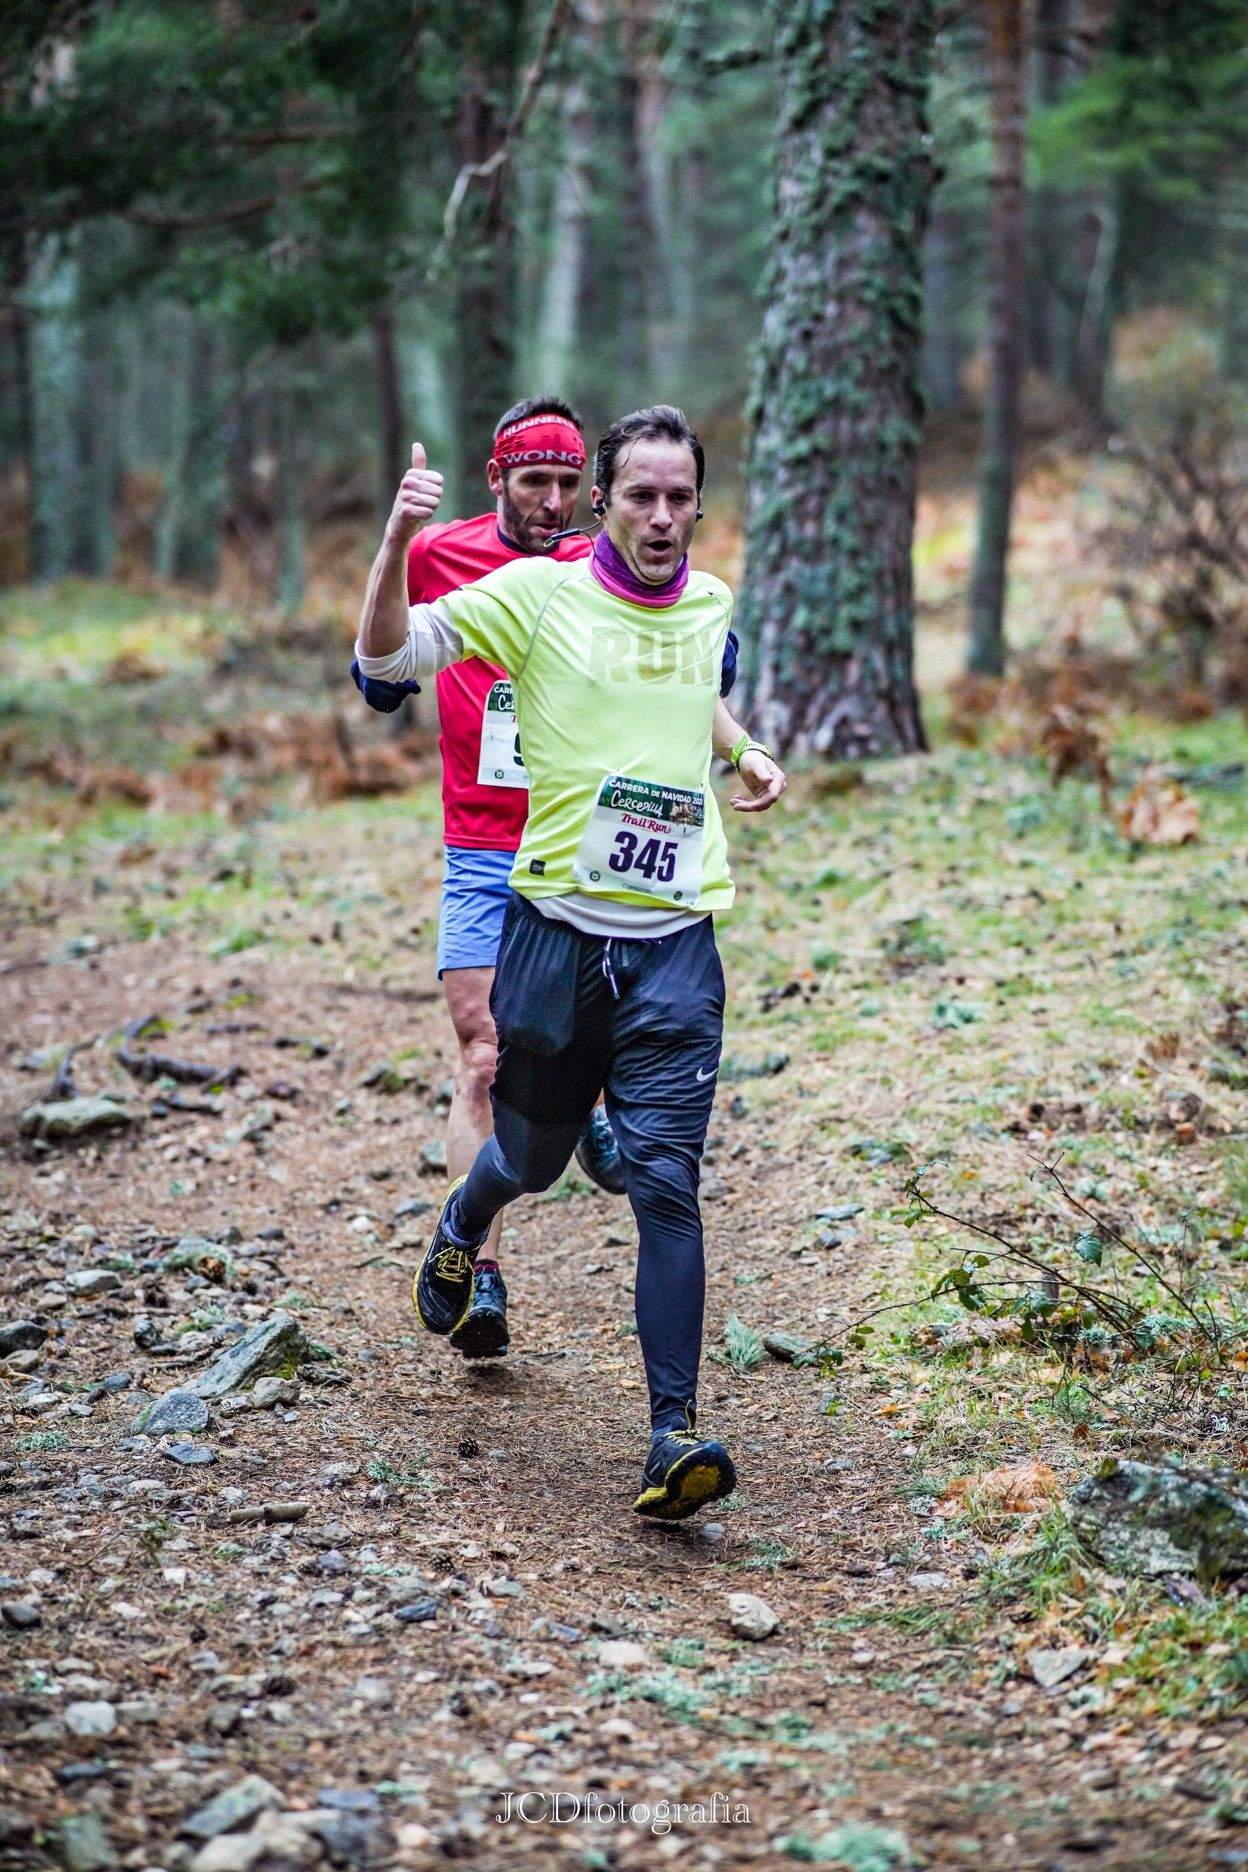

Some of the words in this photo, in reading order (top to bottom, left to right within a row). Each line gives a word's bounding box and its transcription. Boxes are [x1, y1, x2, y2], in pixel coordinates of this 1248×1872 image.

[505, 450, 582, 464] WONG
[588, 625, 714, 686] RUN
[609, 780, 650, 795] CARRERA
[661, 791, 692, 804] NAVIDAD
[621, 813, 648, 828] Trail
[647, 819, 671, 834] Run
[608, 831, 679, 882] 345
